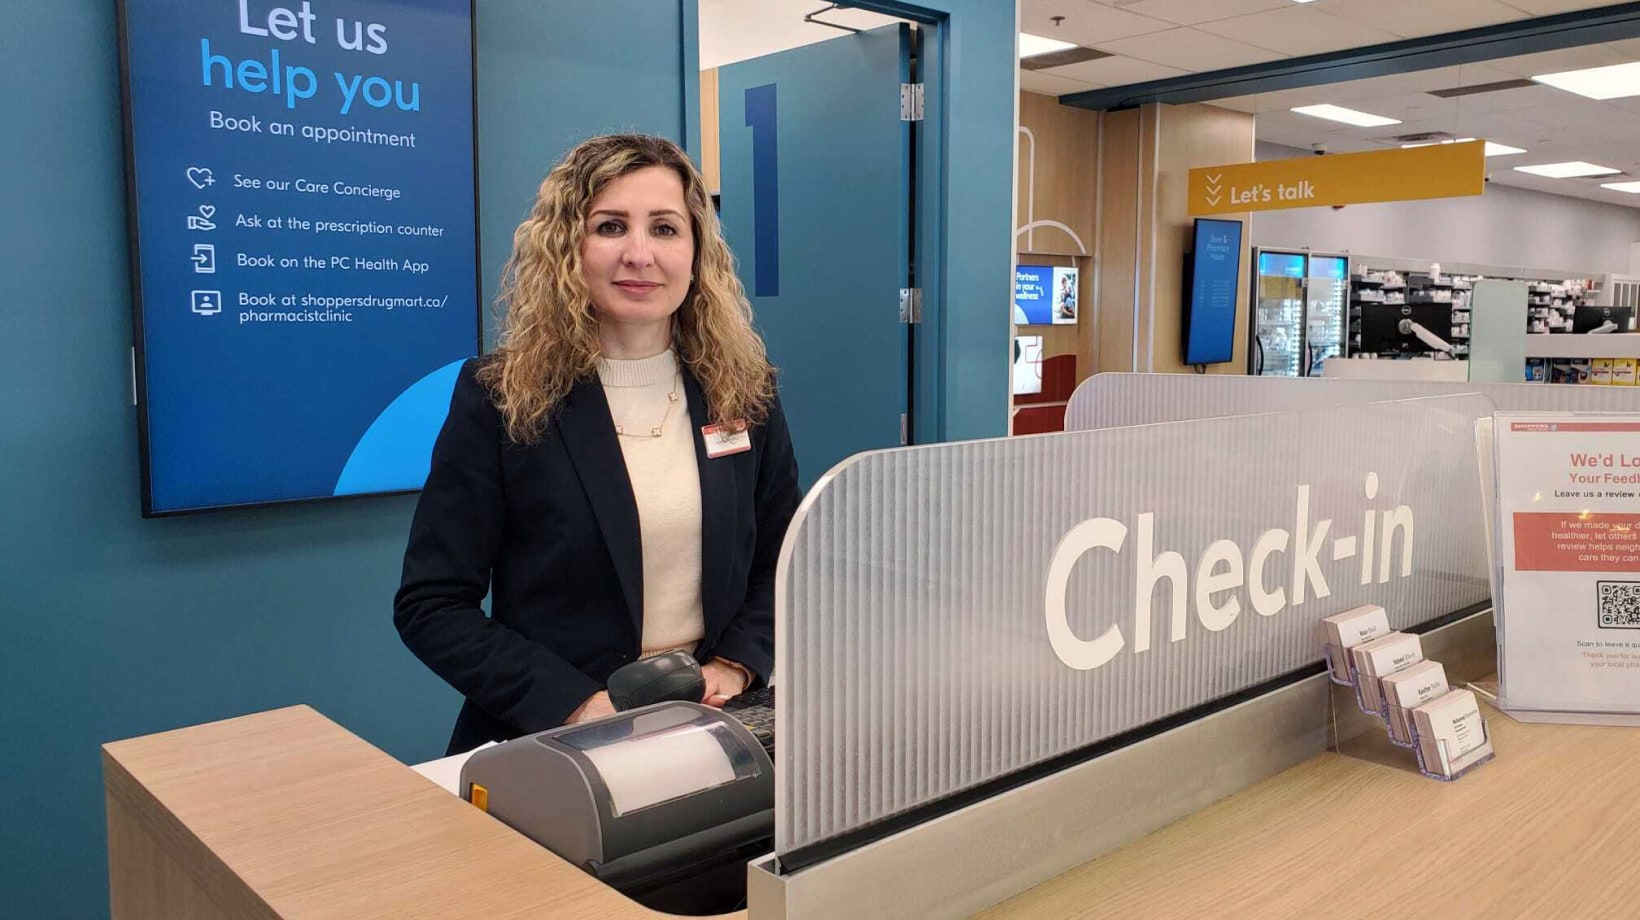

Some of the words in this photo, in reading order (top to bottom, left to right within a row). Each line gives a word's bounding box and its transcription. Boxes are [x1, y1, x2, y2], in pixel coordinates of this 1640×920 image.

[239, 0, 316, 44] Let
[337, 18, 388, 54] us
[201, 39, 318, 109] help
[334, 72, 420, 115] you
[210, 111, 262, 134] Book
[269, 122, 294, 137] an
[301, 125, 416, 148] appointment
[234, 174, 261, 189] See
[266, 179, 290, 191] our
[295, 179, 329, 194] Care
[333, 181, 401, 201] Concierge
[745, 83, 779, 297] 1
[1230, 184, 1272, 205] Let's
[1277, 180, 1315, 200] talk
[235, 214, 262, 228] Ask
[267, 217, 282, 229] at
[287, 217, 311, 230] the
[315, 220, 393, 236] prescription
[397, 225, 444, 237] counter
[237, 253, 275, 267] Book
[280, 258, 299, 268] on
[303, 256, 326, 269] the
[331, 256, 350, 269] PC
[355, 258, 398, 271] Health
[402, 259, 429, 274] App
[1022, 284, 1035, 294] your
[239, 293, 277, 306] Book
[281, 295, 296, 306] at
[301, 294, 448, 310] shoppersdrugmart.ca/
[239, 309, 353, 324] pharmacistclinic
[1570, 453, 1613, 467] We'd
[1620, 454, 1640, 467] Lo
[1569, 473, 1601, 484] Your
[1554, 490, 1580, 498] Leave
[1605, 490, 1635, 498] review
[1561, 520, 1567, 529] If
[1584, 521, 1610, 529] made
[1611, 522, 1632, 531] your
[1551, 531, 1593, 540] healthier,
[1595, 531, 1606, 540] let
[1608, 532, 1637, 540] others
[1557, 543, 1587, 551] review
[1588, 543, 1614, 552] helps
[1600, 554, 1620, 563] they
[1045, 471, 1414, 670] Check-in
